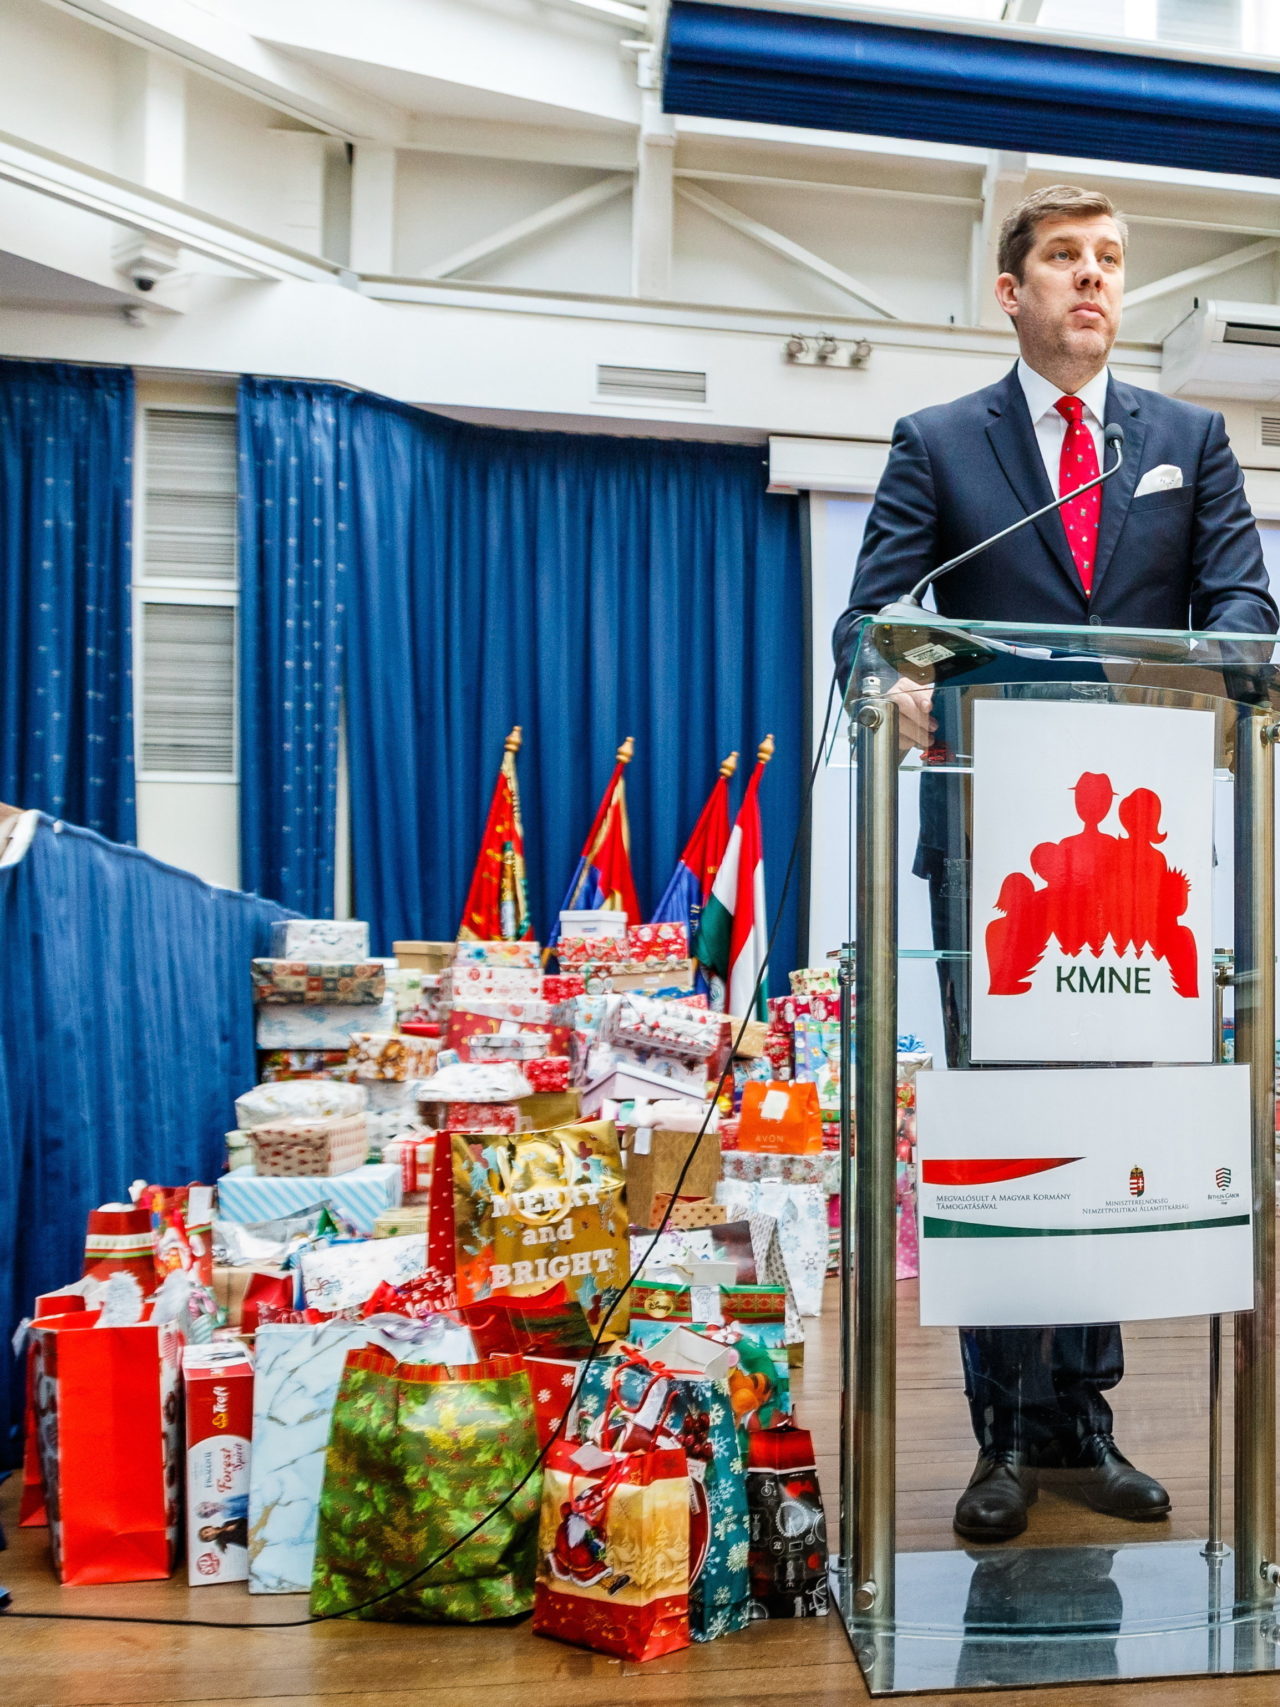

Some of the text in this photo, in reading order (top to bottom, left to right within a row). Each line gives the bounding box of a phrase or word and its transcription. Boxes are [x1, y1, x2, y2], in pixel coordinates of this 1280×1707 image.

[1056, 965, 1151, 994] KMNE
[755, 1134, 784, 1143] AVON
[490, 1183, 600, 1218] MERRY
[936, 1194, 989, 1202] MEGVALÓSULT
[1000, 1194, 1031, 1202] MAGYAR
[1033, 1192, 1073, 1201] KORMÁNY
[936, 1202, 998, 1210] TÁMOGATÁSÁVAL
[522, 1217, 575, 1246] and
[489, 1248, 614, 1289] BRIGHT
[217, 1447, 234, 1493] Forest
